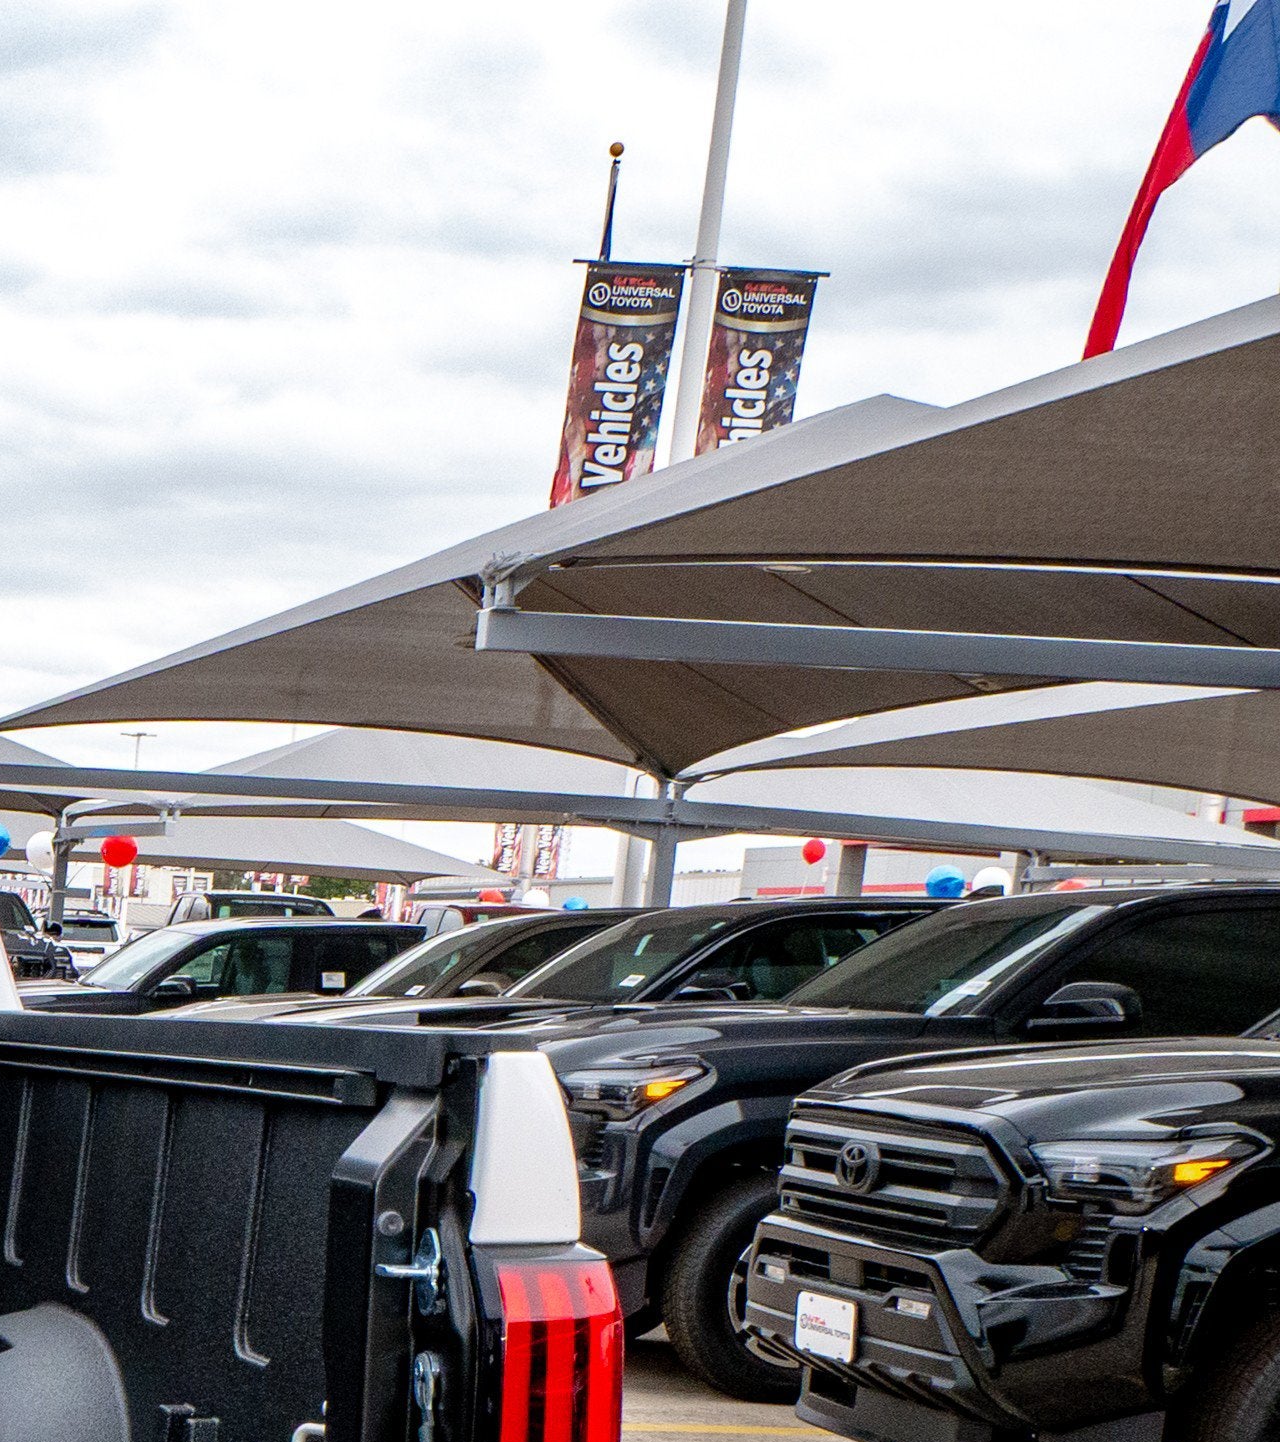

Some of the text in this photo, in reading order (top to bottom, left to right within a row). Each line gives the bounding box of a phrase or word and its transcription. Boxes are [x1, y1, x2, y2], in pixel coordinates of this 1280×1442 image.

[612, 285, 676, 298] UNIVERSAL
[610, 296, 653, 308] TOYOTA
[743, 292, 807, 305] UNIVERSAL
[742, 302, 784, 315] TOYOTA
[580, 342, 644, 488] Vehicles
